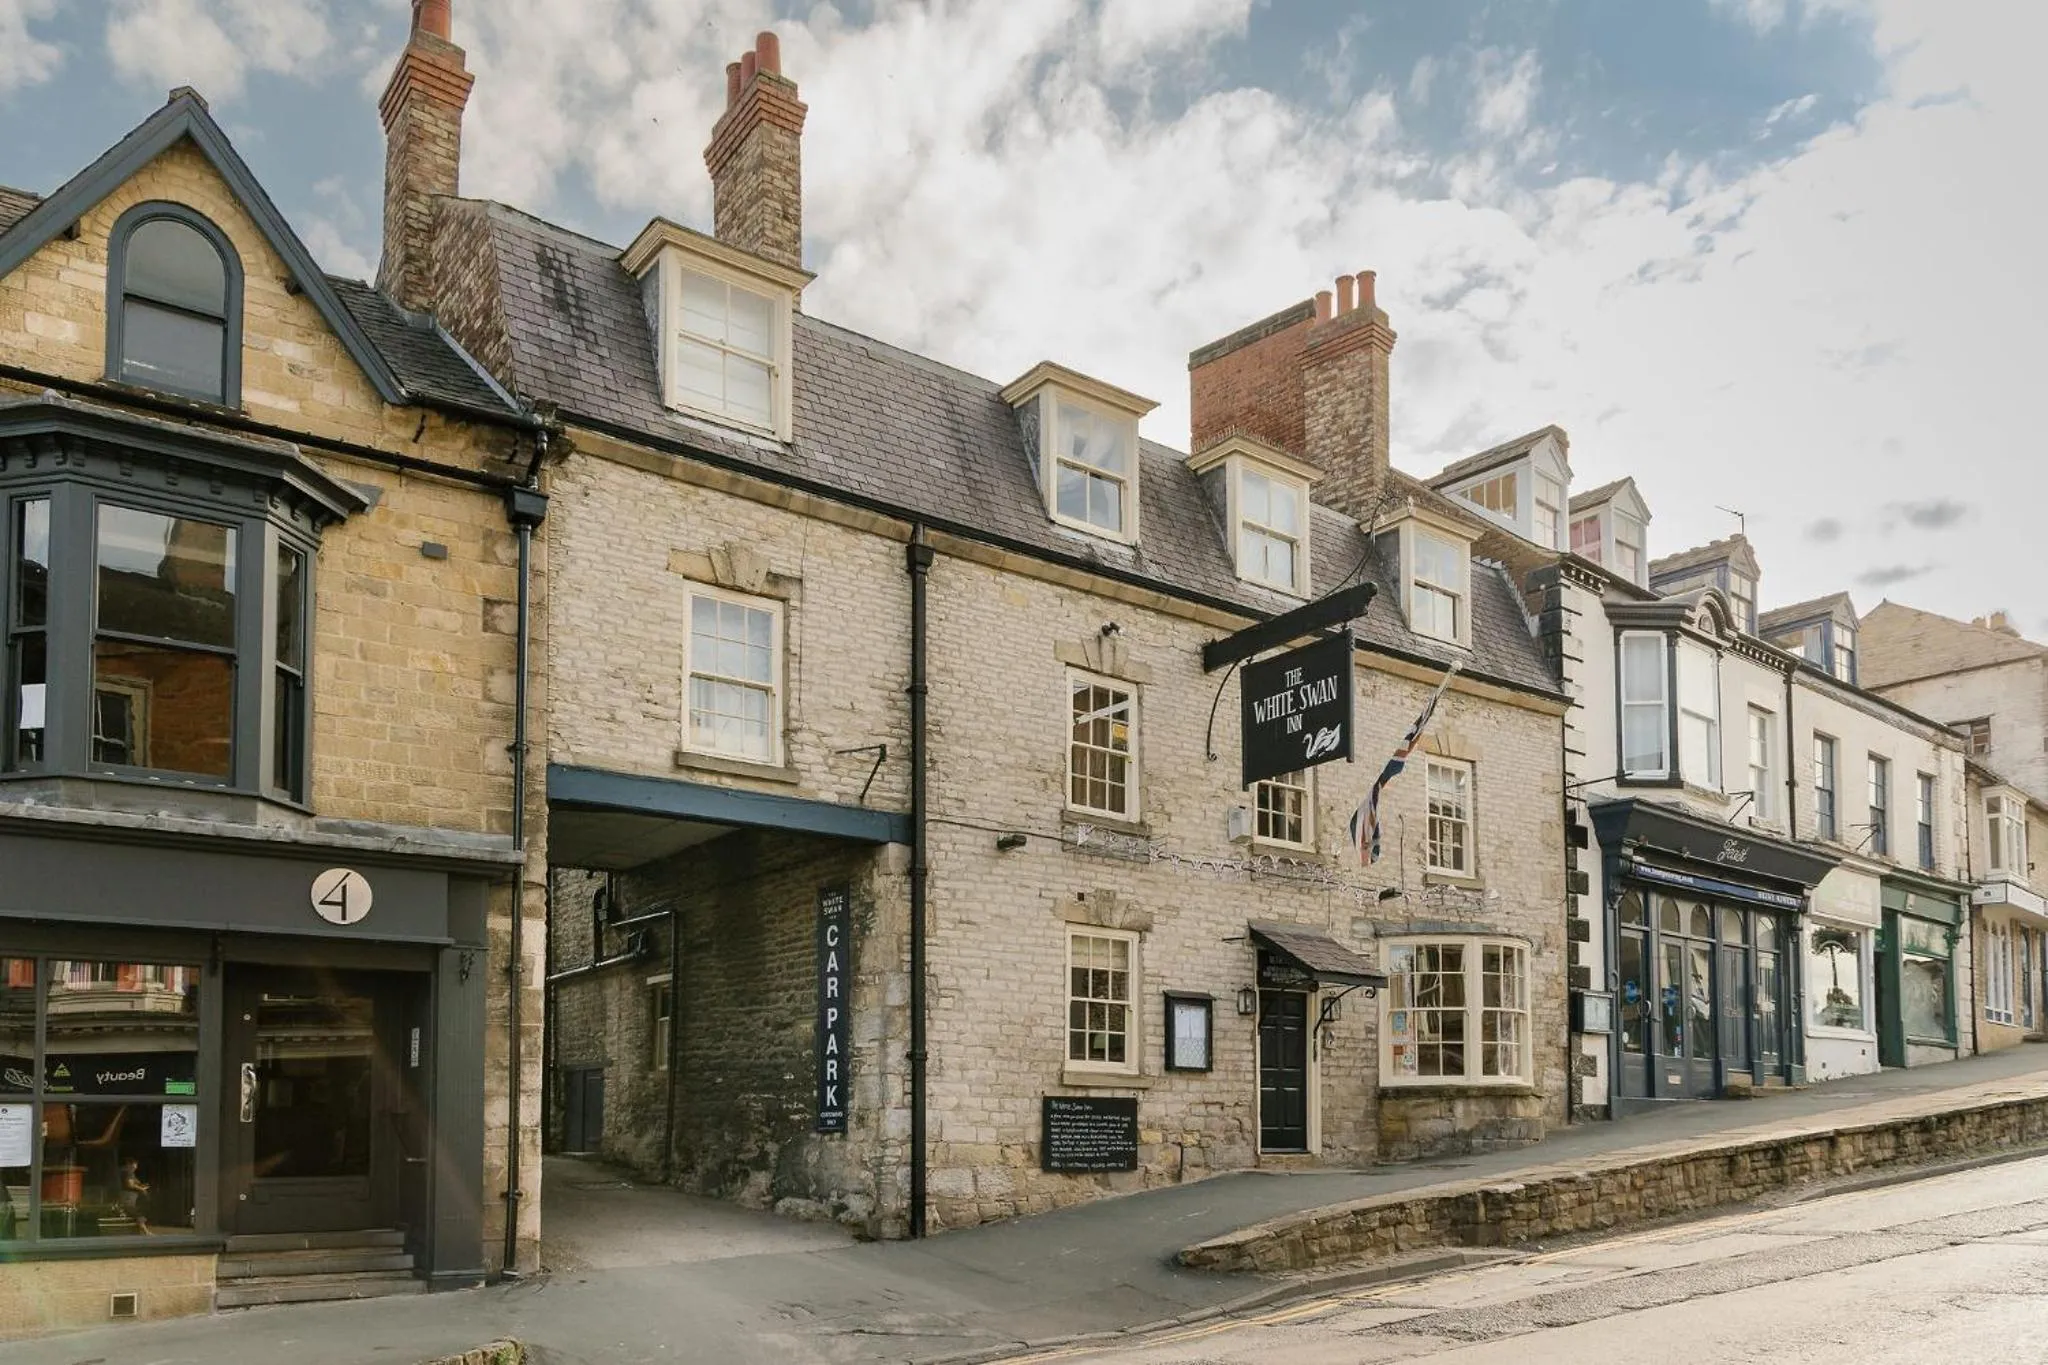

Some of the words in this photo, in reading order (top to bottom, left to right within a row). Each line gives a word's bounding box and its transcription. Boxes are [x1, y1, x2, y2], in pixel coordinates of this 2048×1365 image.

[1253, 689, 1297, 724] WHITE
[1299, 675, 1338, 710] SWAN
[1284, 667, 1303, 688] THE
[1286, 713, 1303, 735] INN
[318, 871, 352, 921] 4
[826, 925, 839, 999] CAR
[826, 1007, 839, 1107] PARK
